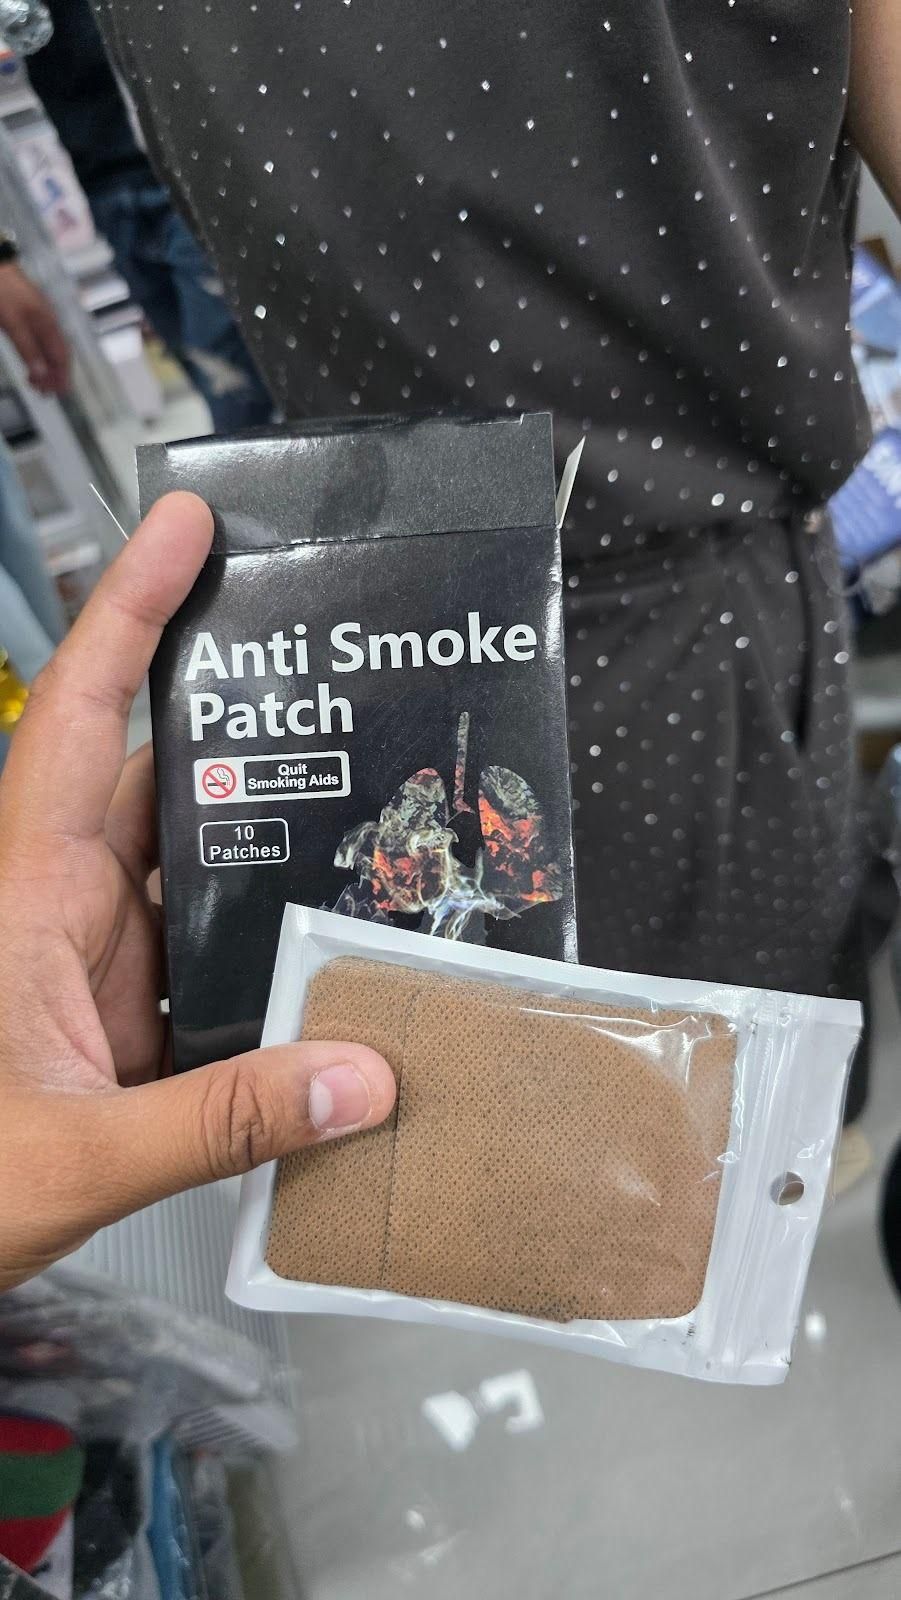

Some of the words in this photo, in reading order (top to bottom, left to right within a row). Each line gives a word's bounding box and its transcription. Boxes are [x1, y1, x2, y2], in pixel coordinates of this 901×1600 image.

[185, 624, 308, 681] Anti
[331, 612, 537, 672] Smoke
[190, 683, 353, 741] Patch
[278, 763, 308, 776] Quit
[248, 776, 306, 790] Smoking
[309, 774, 339, 786] Aids
[234, 826, 254, 841] 10
[210, 844, 281, 860] Patches
